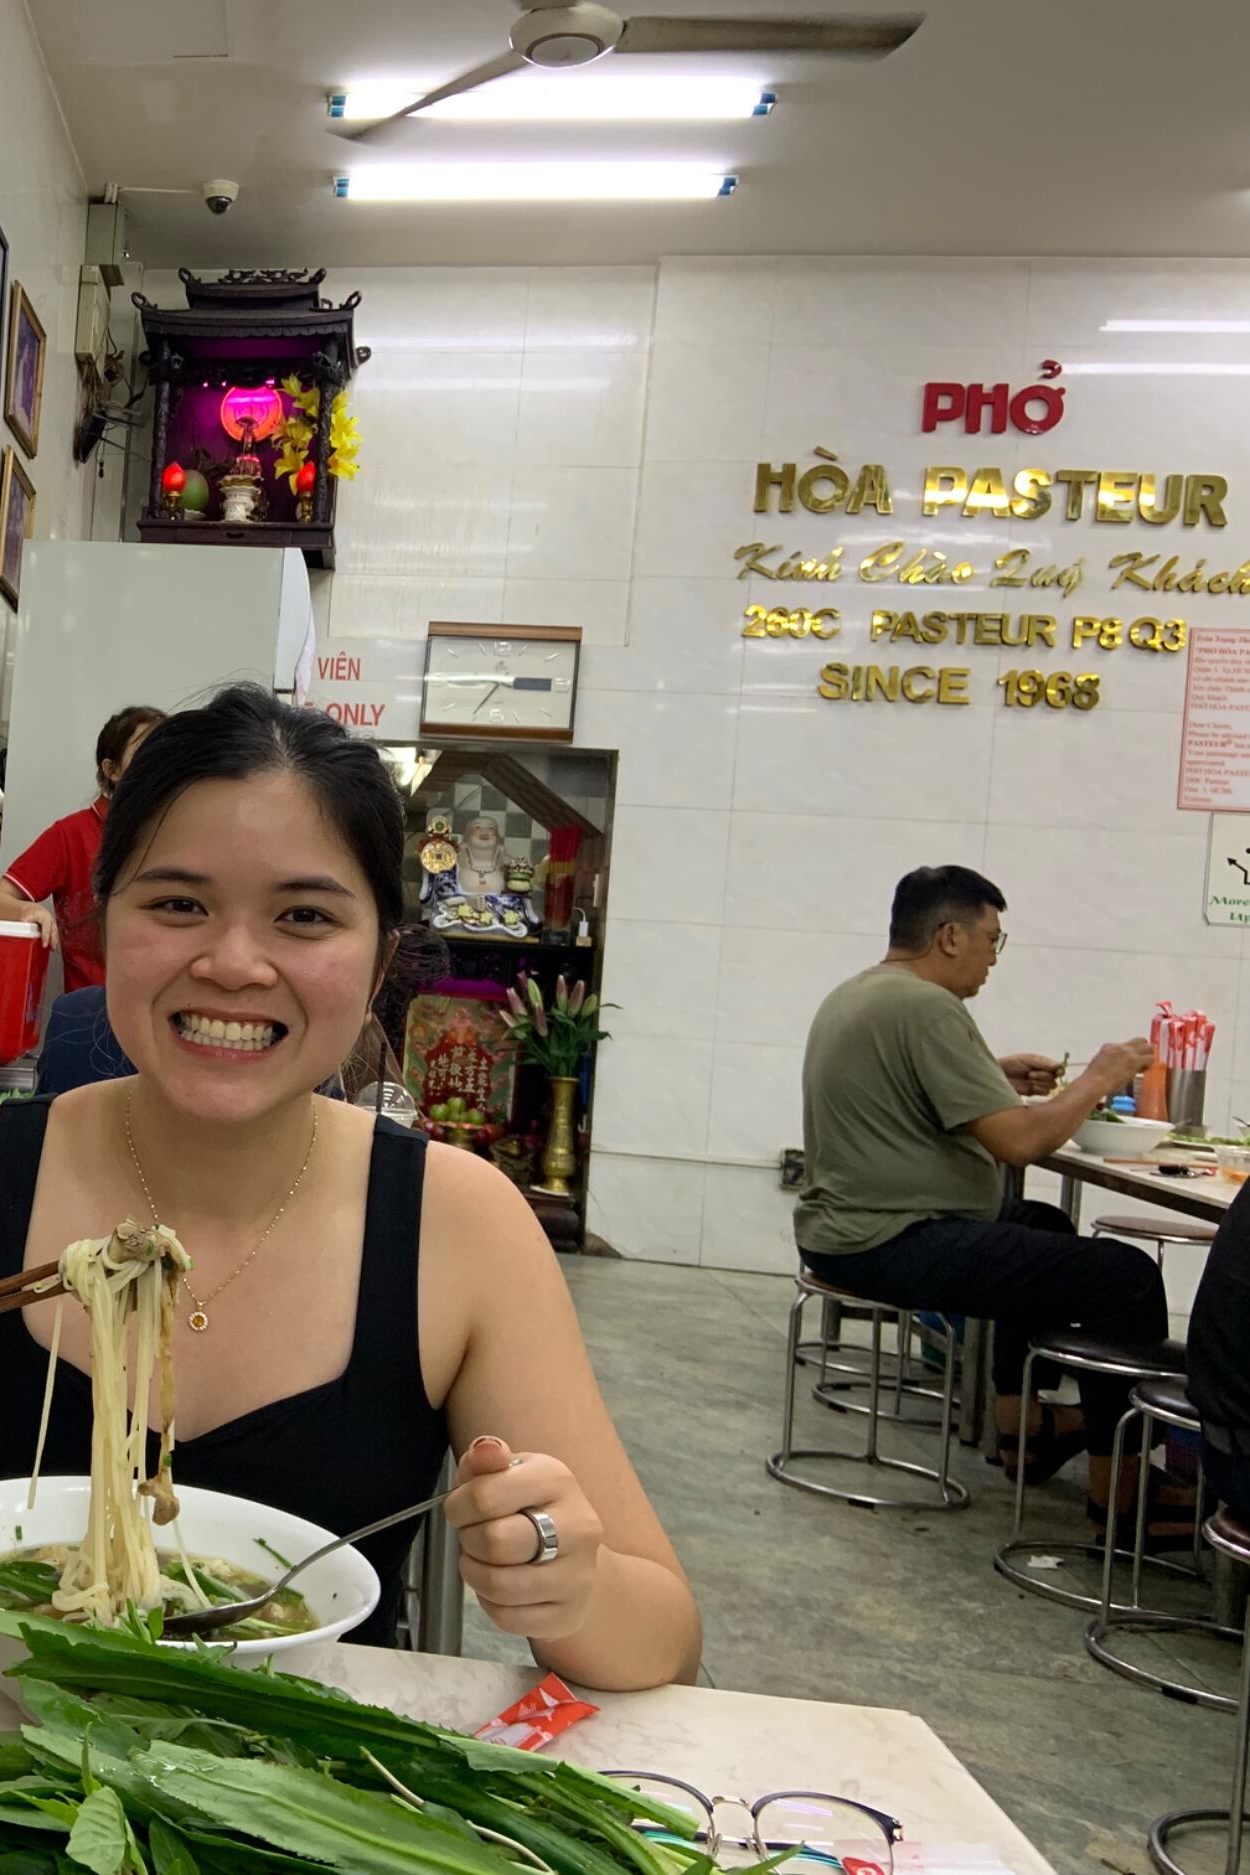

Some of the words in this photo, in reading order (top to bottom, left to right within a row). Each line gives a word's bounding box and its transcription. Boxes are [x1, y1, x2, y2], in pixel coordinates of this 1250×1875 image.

[922, 359, 1066, 434] PHỞ
[754, 446, 893, 515] HÒA
[922, 467, 1228, 527] PASTEUR
[742, 604, 842, 640] 260C
[871, 609, 1057, 647] PASTEUR
[1072, 615, 1123, 650] P8
[1128, 615, 1187, 652] Q3
[318, 651, 361, 680] VIÊN
[818, 662, 971, 705] SINCE
[997, 668, 1100, 711] 1968
[326, 703, 386, 727] ONLY
